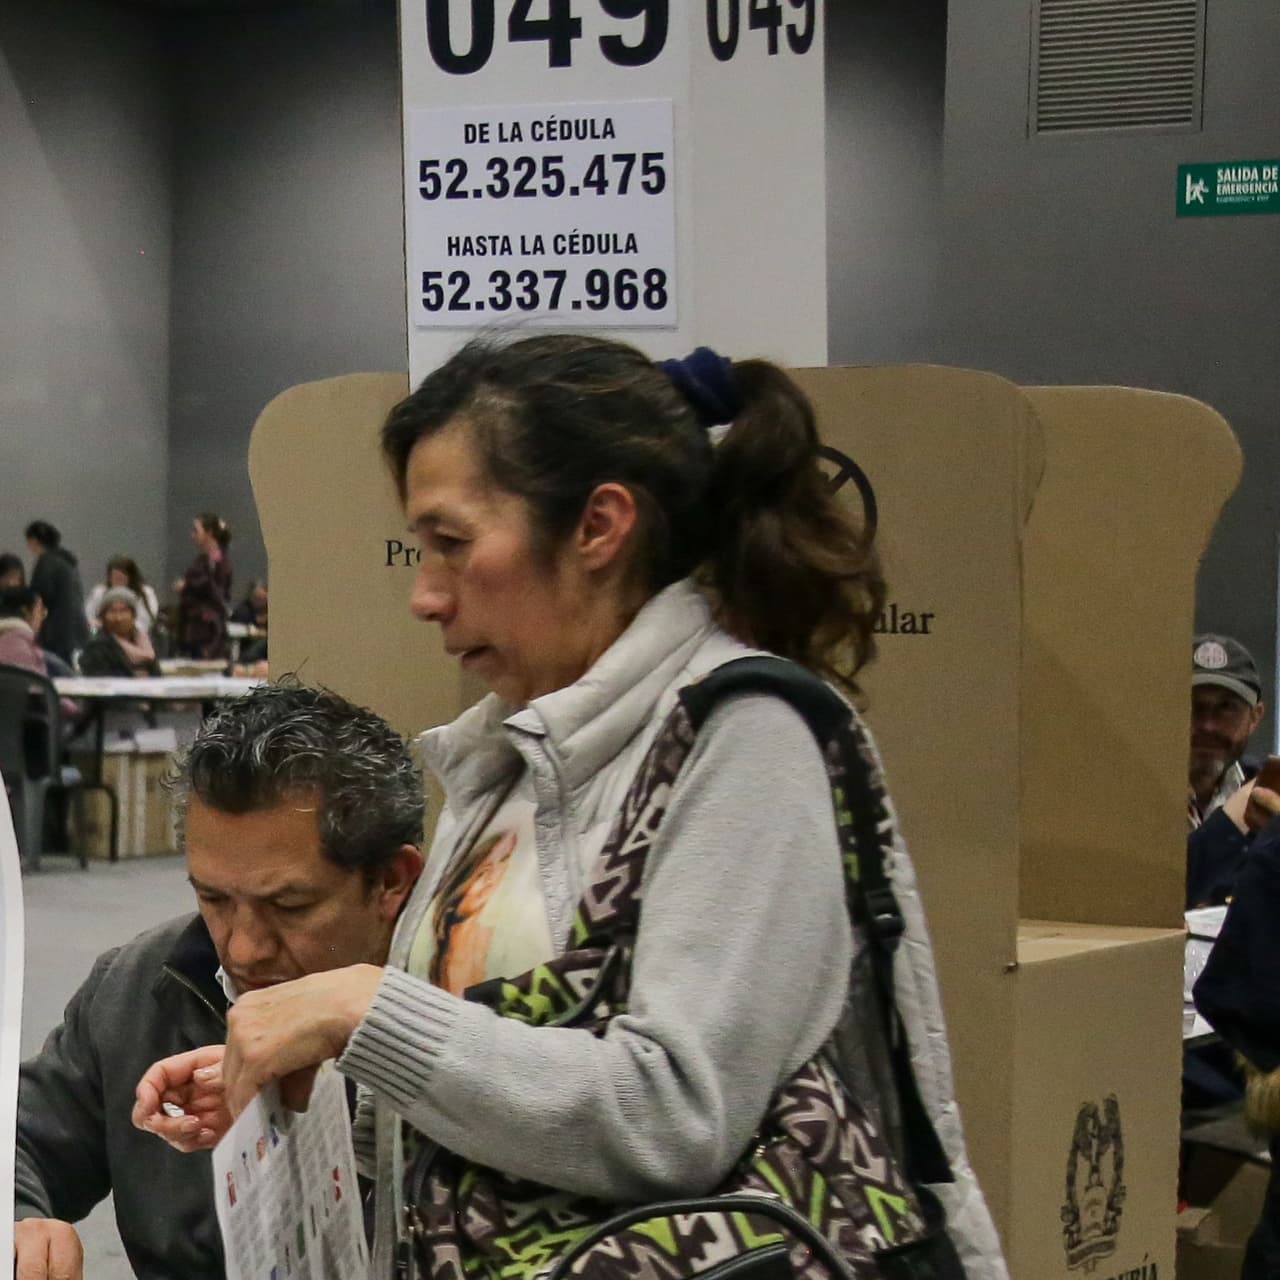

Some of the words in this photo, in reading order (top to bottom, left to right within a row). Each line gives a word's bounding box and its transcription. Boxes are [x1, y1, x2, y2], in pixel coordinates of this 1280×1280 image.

[464, 123, 489, 144] DE
[498, 122, 523, 142] LA
[531, 115, 616, 142] CÉDULA
[418, 152, 666, 200] 52.325.475
[1216, 181, 1279, 196] EMERGENCIA
[1217, 166, 1259, 183] SALIDA
[1262, 166, 1279, 181] DE
[447, 235, 513, 257] HASTA
[520, 234, 545, 255] LA
[553, 229, 639, 255] CÉDULA
[421, 268, 668, 311] 52.337.968
[872, 603, 933, 634] ular
